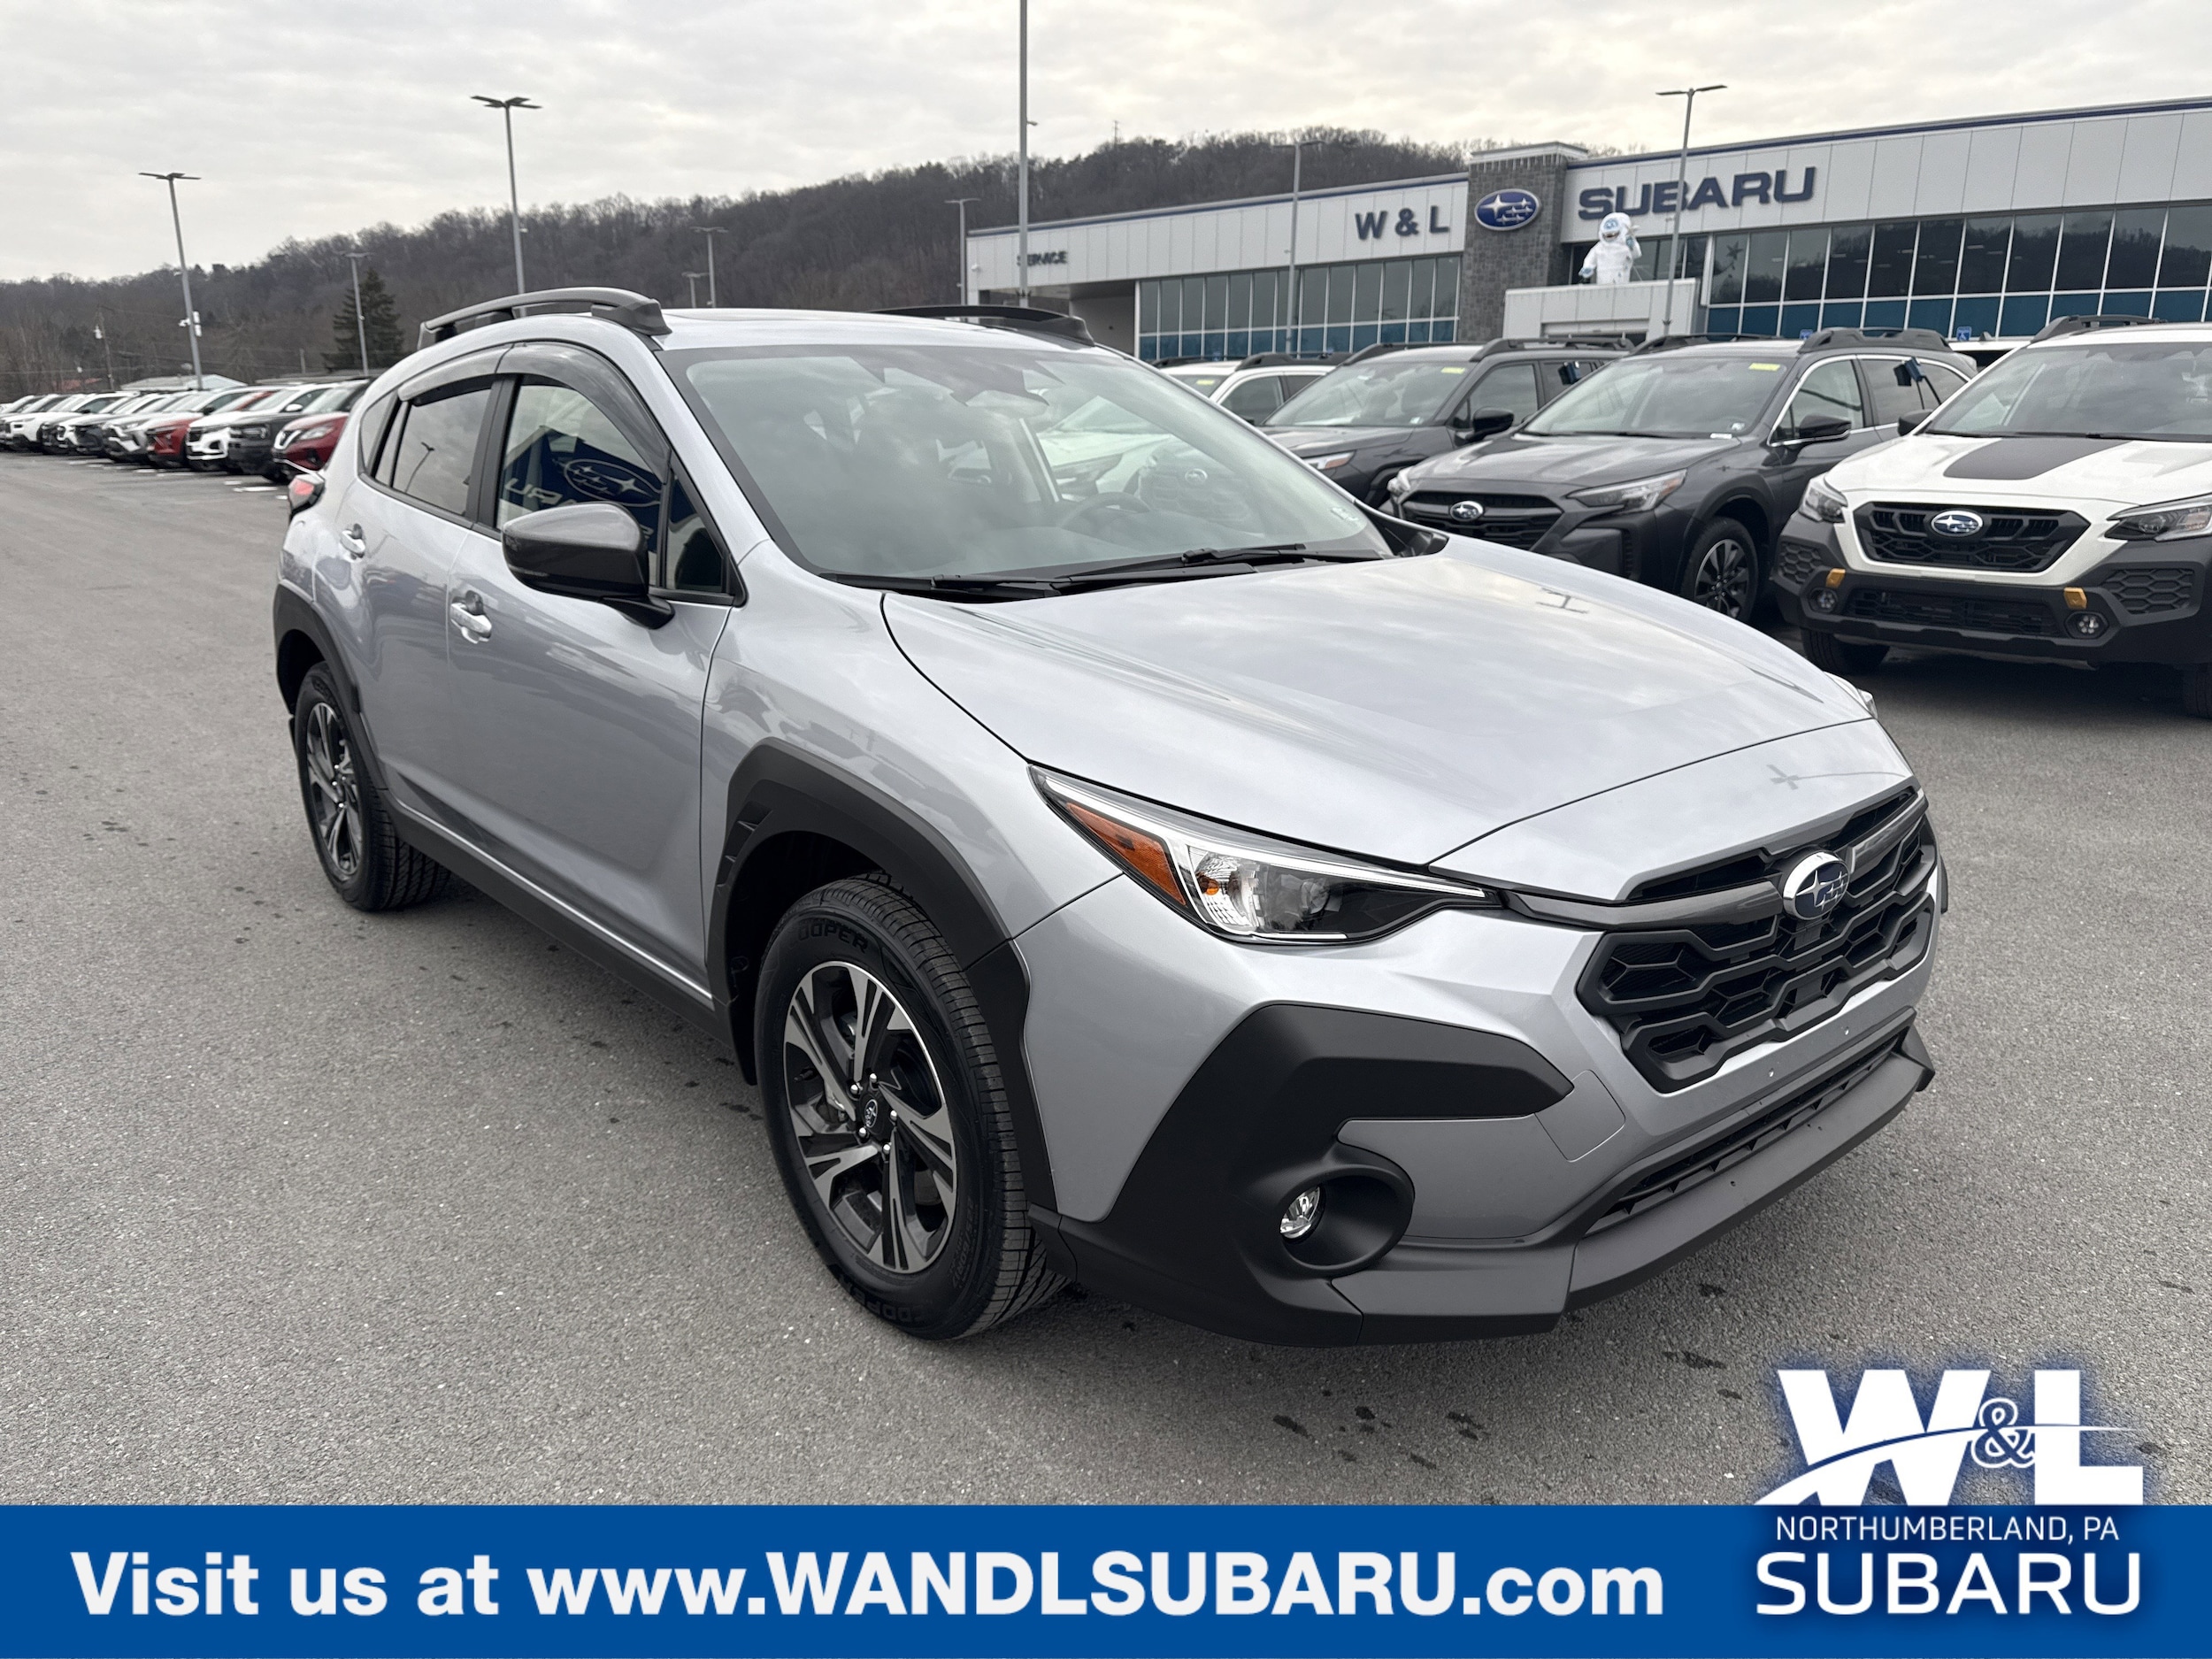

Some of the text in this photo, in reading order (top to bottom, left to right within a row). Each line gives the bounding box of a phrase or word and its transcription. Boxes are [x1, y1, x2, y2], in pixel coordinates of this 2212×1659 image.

[1579, 165, 1816, 220] SUBARU
[1355, 205, 1450, 241] W & L
